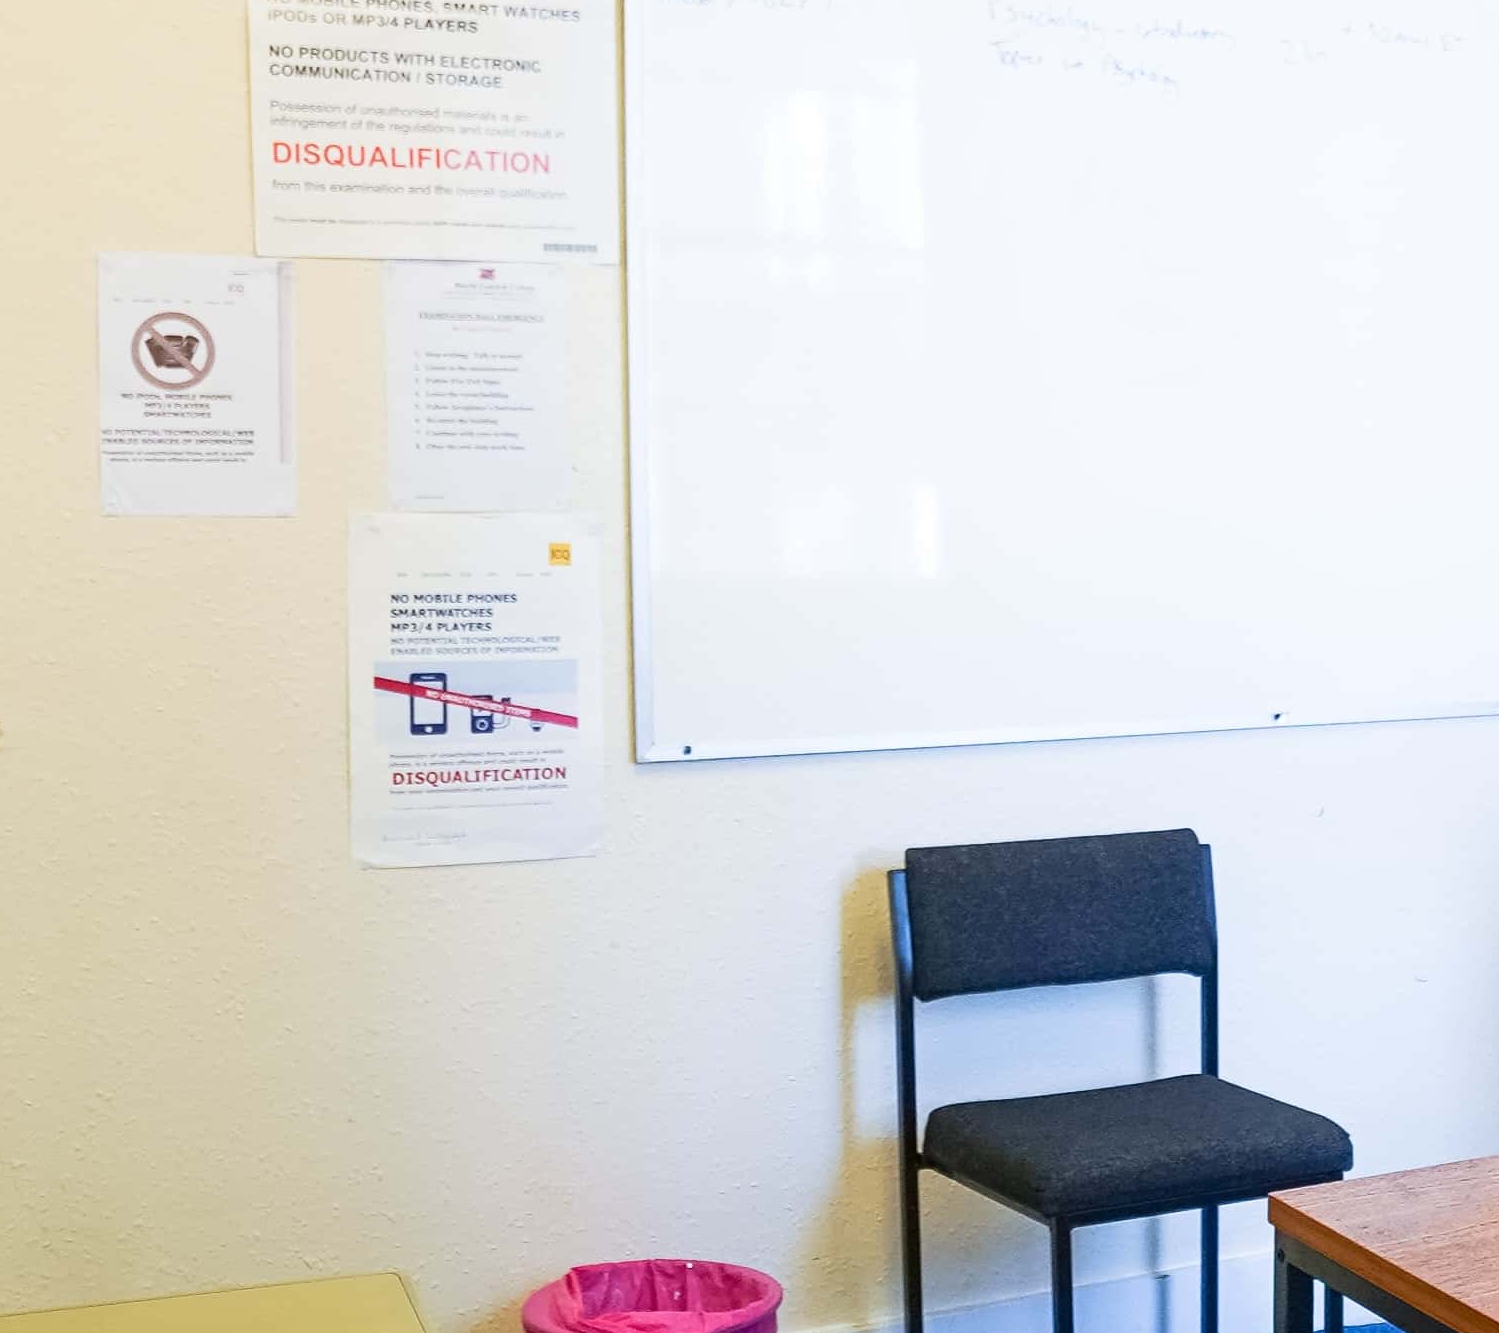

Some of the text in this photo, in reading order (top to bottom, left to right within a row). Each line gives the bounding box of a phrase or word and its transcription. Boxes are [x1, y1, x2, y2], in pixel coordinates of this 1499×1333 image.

[323, 11, 347, 26] OR
[353, 13, 399, 29] MP3/4
[404, 16, 479, 34] PLAYERS
[443, 1, 497, 18] SMART
[504, 6, 581, 24] WATCHES
[269, 44, 541, 74] NO PRODUCTS WITH ELECTRONIC
[269, 64, 411, 84] COMMUNICATION
[426, 72, 503, 89] STORAGE
[272, 142, 551, 174] DISQUALIFICATION
[390, 594, 518, 605] NO MOBILE PHONES
[390, 608, 494, 619] SMARTWATCHES
[390, 622, 493, 634] MP3/4 PLAYERS
[392, 766, 567, 787] DISQUALIFICATION
